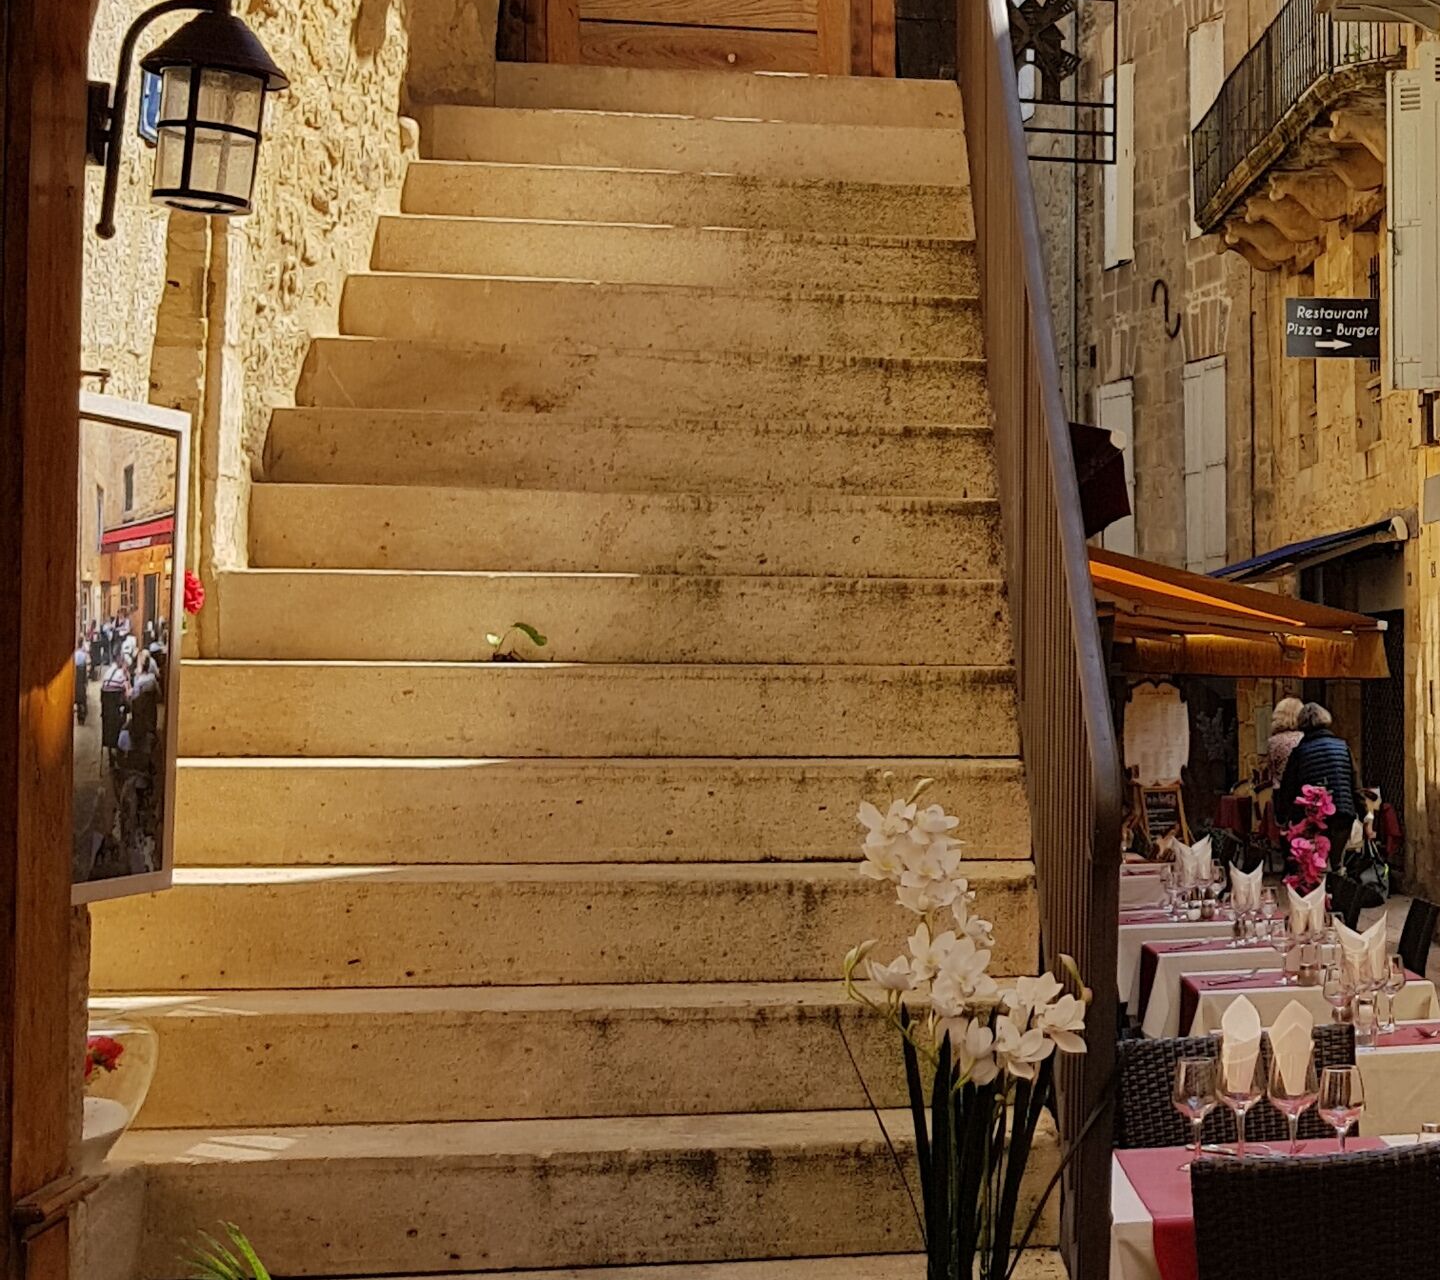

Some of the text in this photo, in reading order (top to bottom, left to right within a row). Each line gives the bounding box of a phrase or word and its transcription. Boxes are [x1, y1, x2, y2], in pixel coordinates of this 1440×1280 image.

[1296, 305, 1369, 320] Restaurant
[1286, 322, 1323, 336] Pizza
[1336, 322, 1380, 338] Burger
